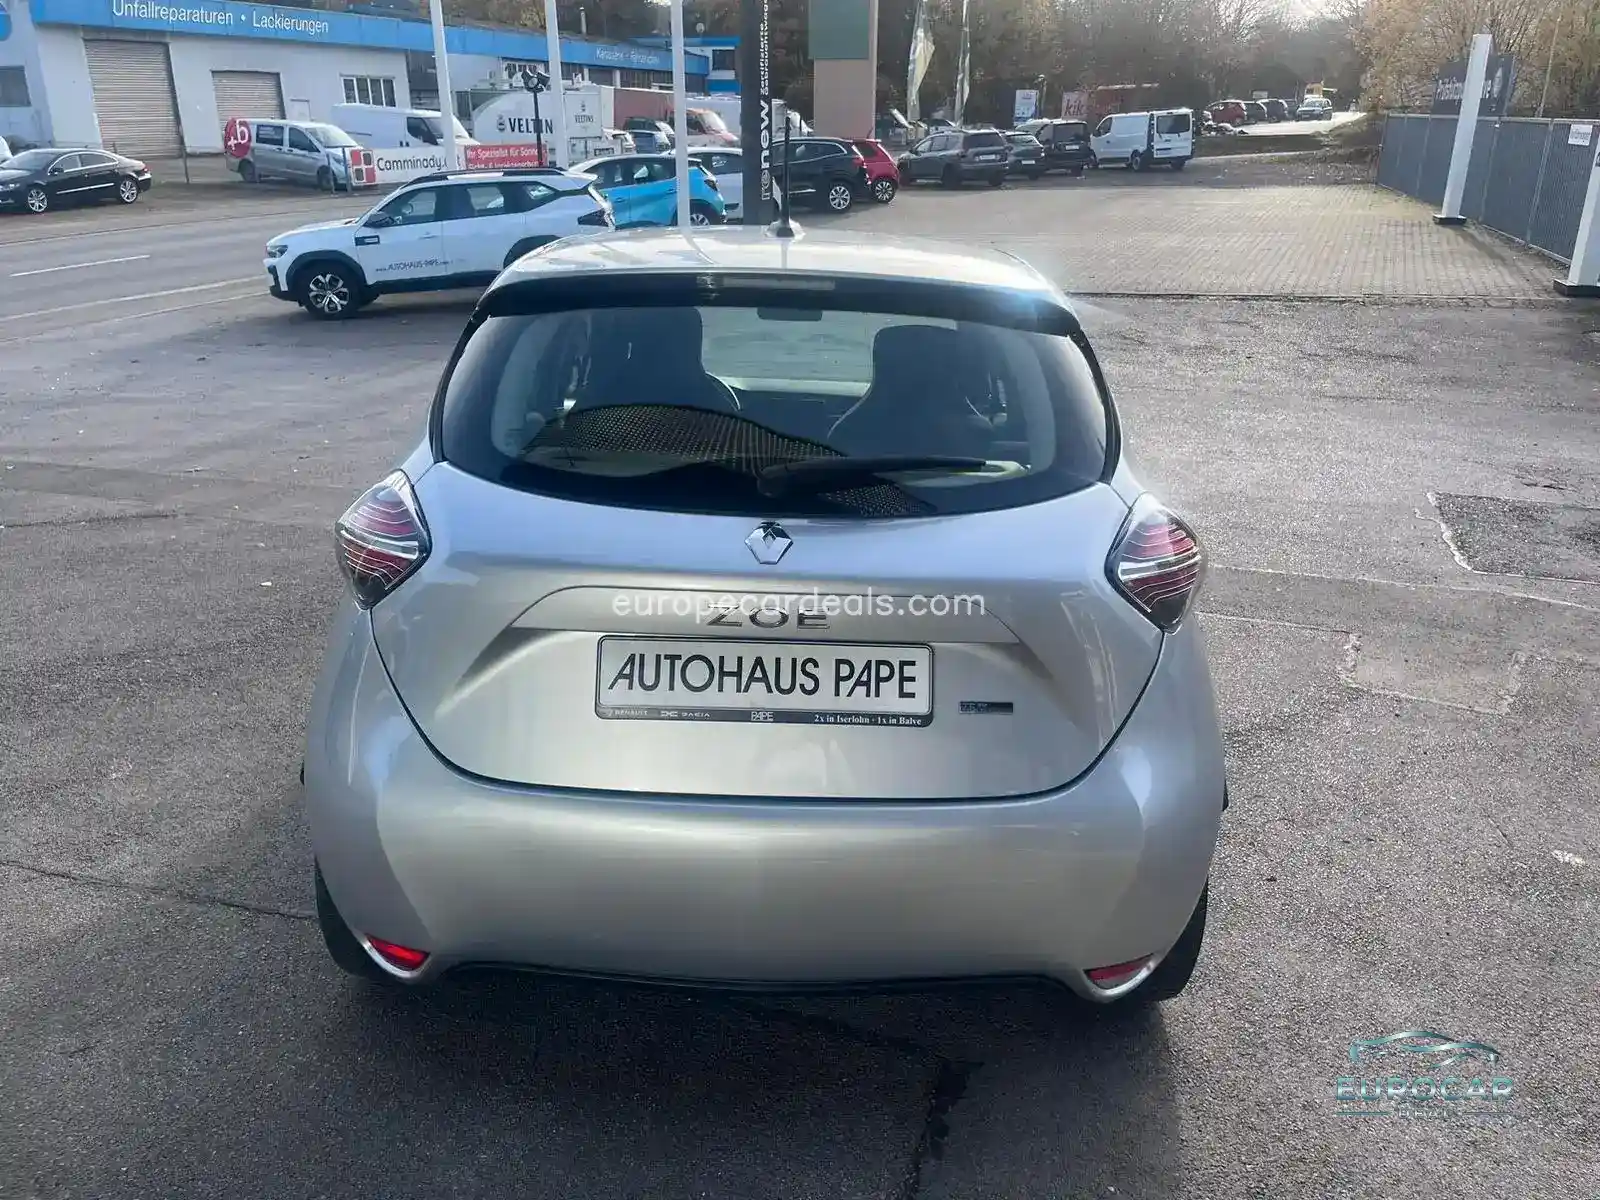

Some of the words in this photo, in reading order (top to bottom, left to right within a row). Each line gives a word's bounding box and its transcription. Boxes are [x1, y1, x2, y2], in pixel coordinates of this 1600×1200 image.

[112, 0, 233, 25] Unfallreparaturen
[253, 11, 329, 35] Lackierungen
[508, 117, 554, 134] VELTIN
[706, 603, 831, 630] ZOE
[608, 653, 820, 696] AUTOHAUS
[834, 658, 918, 700] PAPE
[751, 711, 774, 722] PAPE
[814, 714, 824, 723] 2x
[826, 714, 835, 723] in
[837, 715, 870, 724] Iserlohn
[877, 716, 887, 724] 1x
[889, 716, 897, 725] in
[899, 717, 922, 726] Balve
